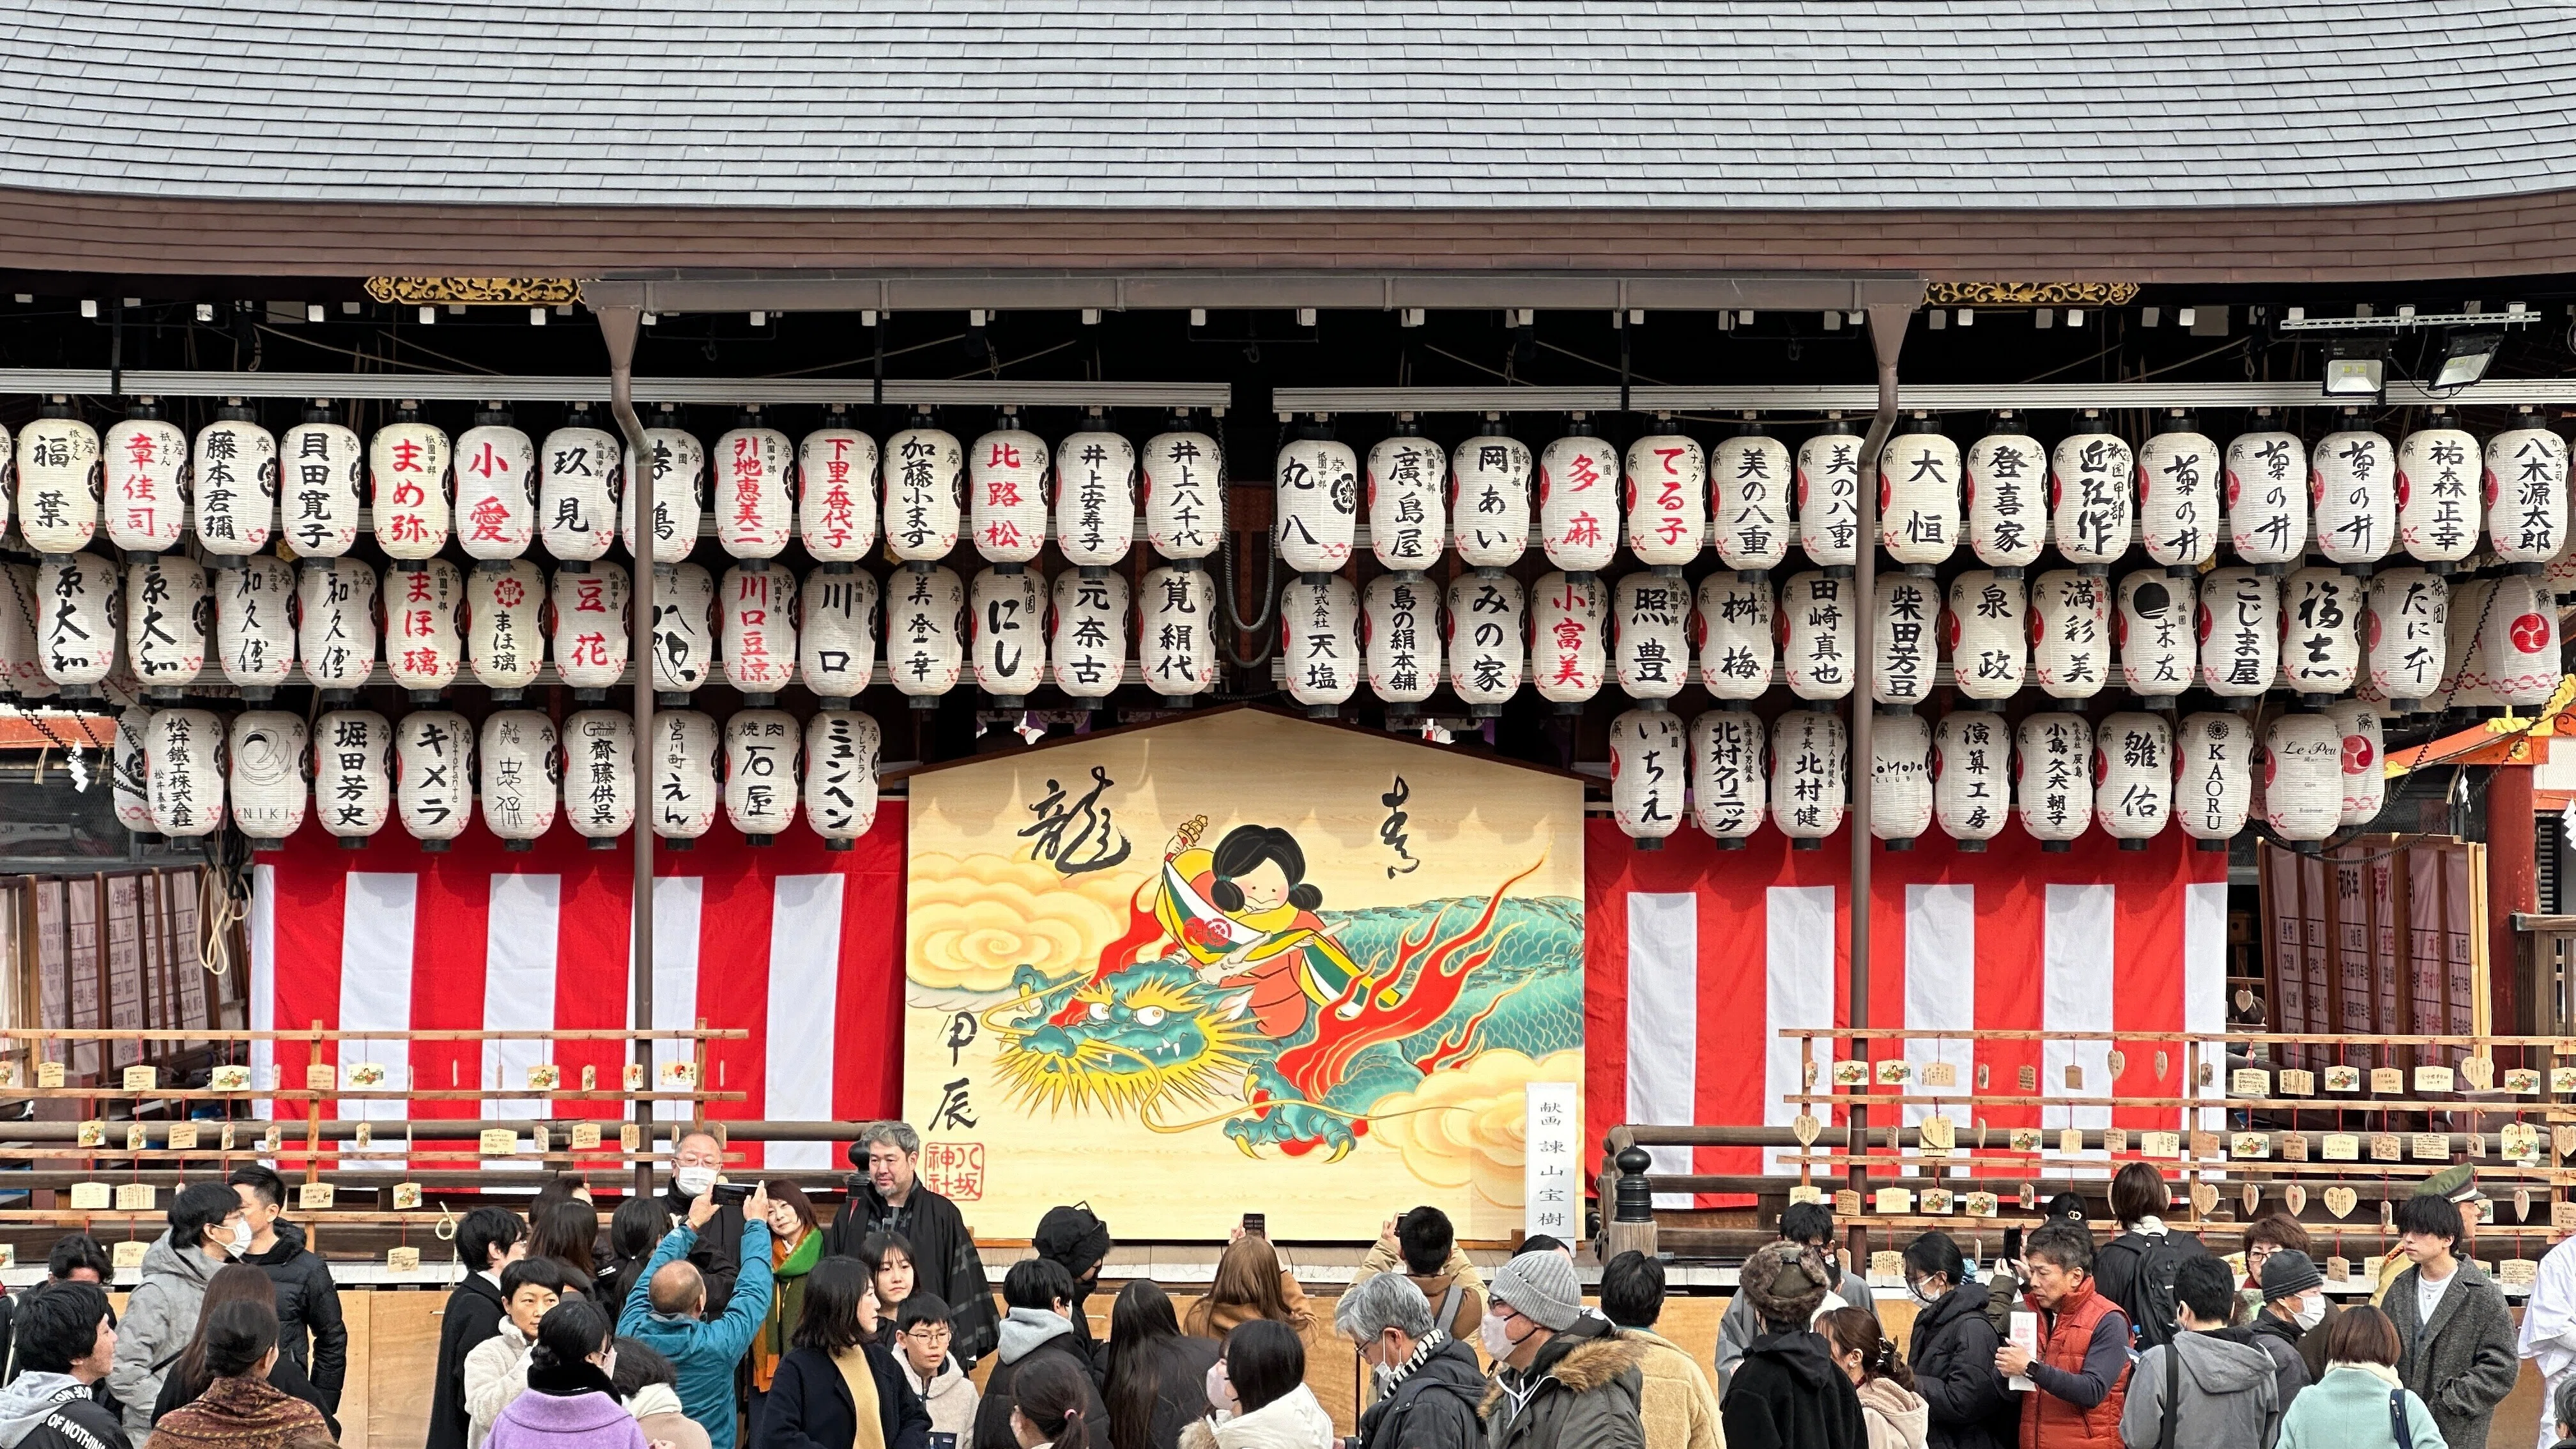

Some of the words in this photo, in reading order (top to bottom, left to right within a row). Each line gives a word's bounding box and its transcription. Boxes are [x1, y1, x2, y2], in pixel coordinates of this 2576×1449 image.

[33, 434, 70, 528] 福葉
[124, 433, 156, 537] 章佳司
[392, 439, 429, 543] まめ弥
[470, 443, 511, 543] 小愛
[551, 447, 592, 533] 玖見
[733, 438, 763, 543] 引地恵美二
[823, 438, 854, 549] 下里香代子
[900, 435, 936, 548] 加藤小ます
[986, 444, 1022, 548] 比路松
[1078, 444, 1108, 552] 井上安寿子
[1167, 440, 1205, 547] 井上八千代
[1280, 456, 1320, 545] 丸八
[1388, 446, 1425, 558] 廣島屋
[1476, 445, 1508, 549] 岡あい
[1563, 454, 1601, 548] 多麻
[1654, 447, 1687, 546] てる子
[1687, 444, 1699, 482] スナック
[1733, 447, 1774, 555] 美の八重
[1825, 444, 1857, 548] 美の八重
[1905, 449, 1948, 544] 大恒
[1988, 445, 2029, 553] 登喜家
[2428, 440, 2467, 552] 祐森正幸
[2514, 438, 2554, 555] 八木源太郎
[404, 571, 438, 677] まほ璃
[492, 610, 517, 673] まほ璃
[572, 581, 608, 666] 豆花
[739, 576, 769, 681] 川口豆涼
[818, 582, 853, 673] 川口
[988, 599, 1022, 678] にし
[1070, 580, 1110, 684] 元奈古
[1155, 576, 1196, 682] 筧絹代
[1312, 584, 1330, 628] 株式会社
[1388, 585, 1418, 691] 島の絹本舗
[1473, 585, 1510, 693] みの家
[1632, 588, 1671, 683] 照豊
[1721, 591, 1761, 680] 桝梅
[1808, 579, 1843, 684] 田崎真也
[1883, 585, 1925, 698] 柴田芳豆
[1977, 583, 2014, 680] 泉政
[2060, 579, 2096, 683] 満彩美
[2225, 578, 2262, 685] こじま屋
[2402, 581, 2434, 684] たに本
[1305, 634, 1338, 689] 天塩
[334, 721, 369, 826] 堀田芳史
[416, 723, 451, 825] キメラ
[450, 720, 459, 803] Ristorante
[668, 718, 686, 769] 宮川町
[739, 721, 784, 737] 焼肉
[741, 745, 776, 816] 石屋
[824, 719, 855, 829] ミュンヘン
[1638, 721, 1673, 824] いちえ
[1710, 721, 1745, 832] 北村クリニック
[1963, 722, 1991, 829] 演算工房
[2280, 741, 2304, 755] Le
[243, 808, 288, 819] NIKI
[662, 772, 691, 825] えん
[1018, 766, 1130, 877] 龍
[1793, 751, 1824, 828] 北村健
[2205, 743, 2226, 830] KAORU
[928, 1012, 979, 1131] 甲辰
[1540, 1102, 1563, 1126] 献画
[47, 1413, 65, 1429] OF
